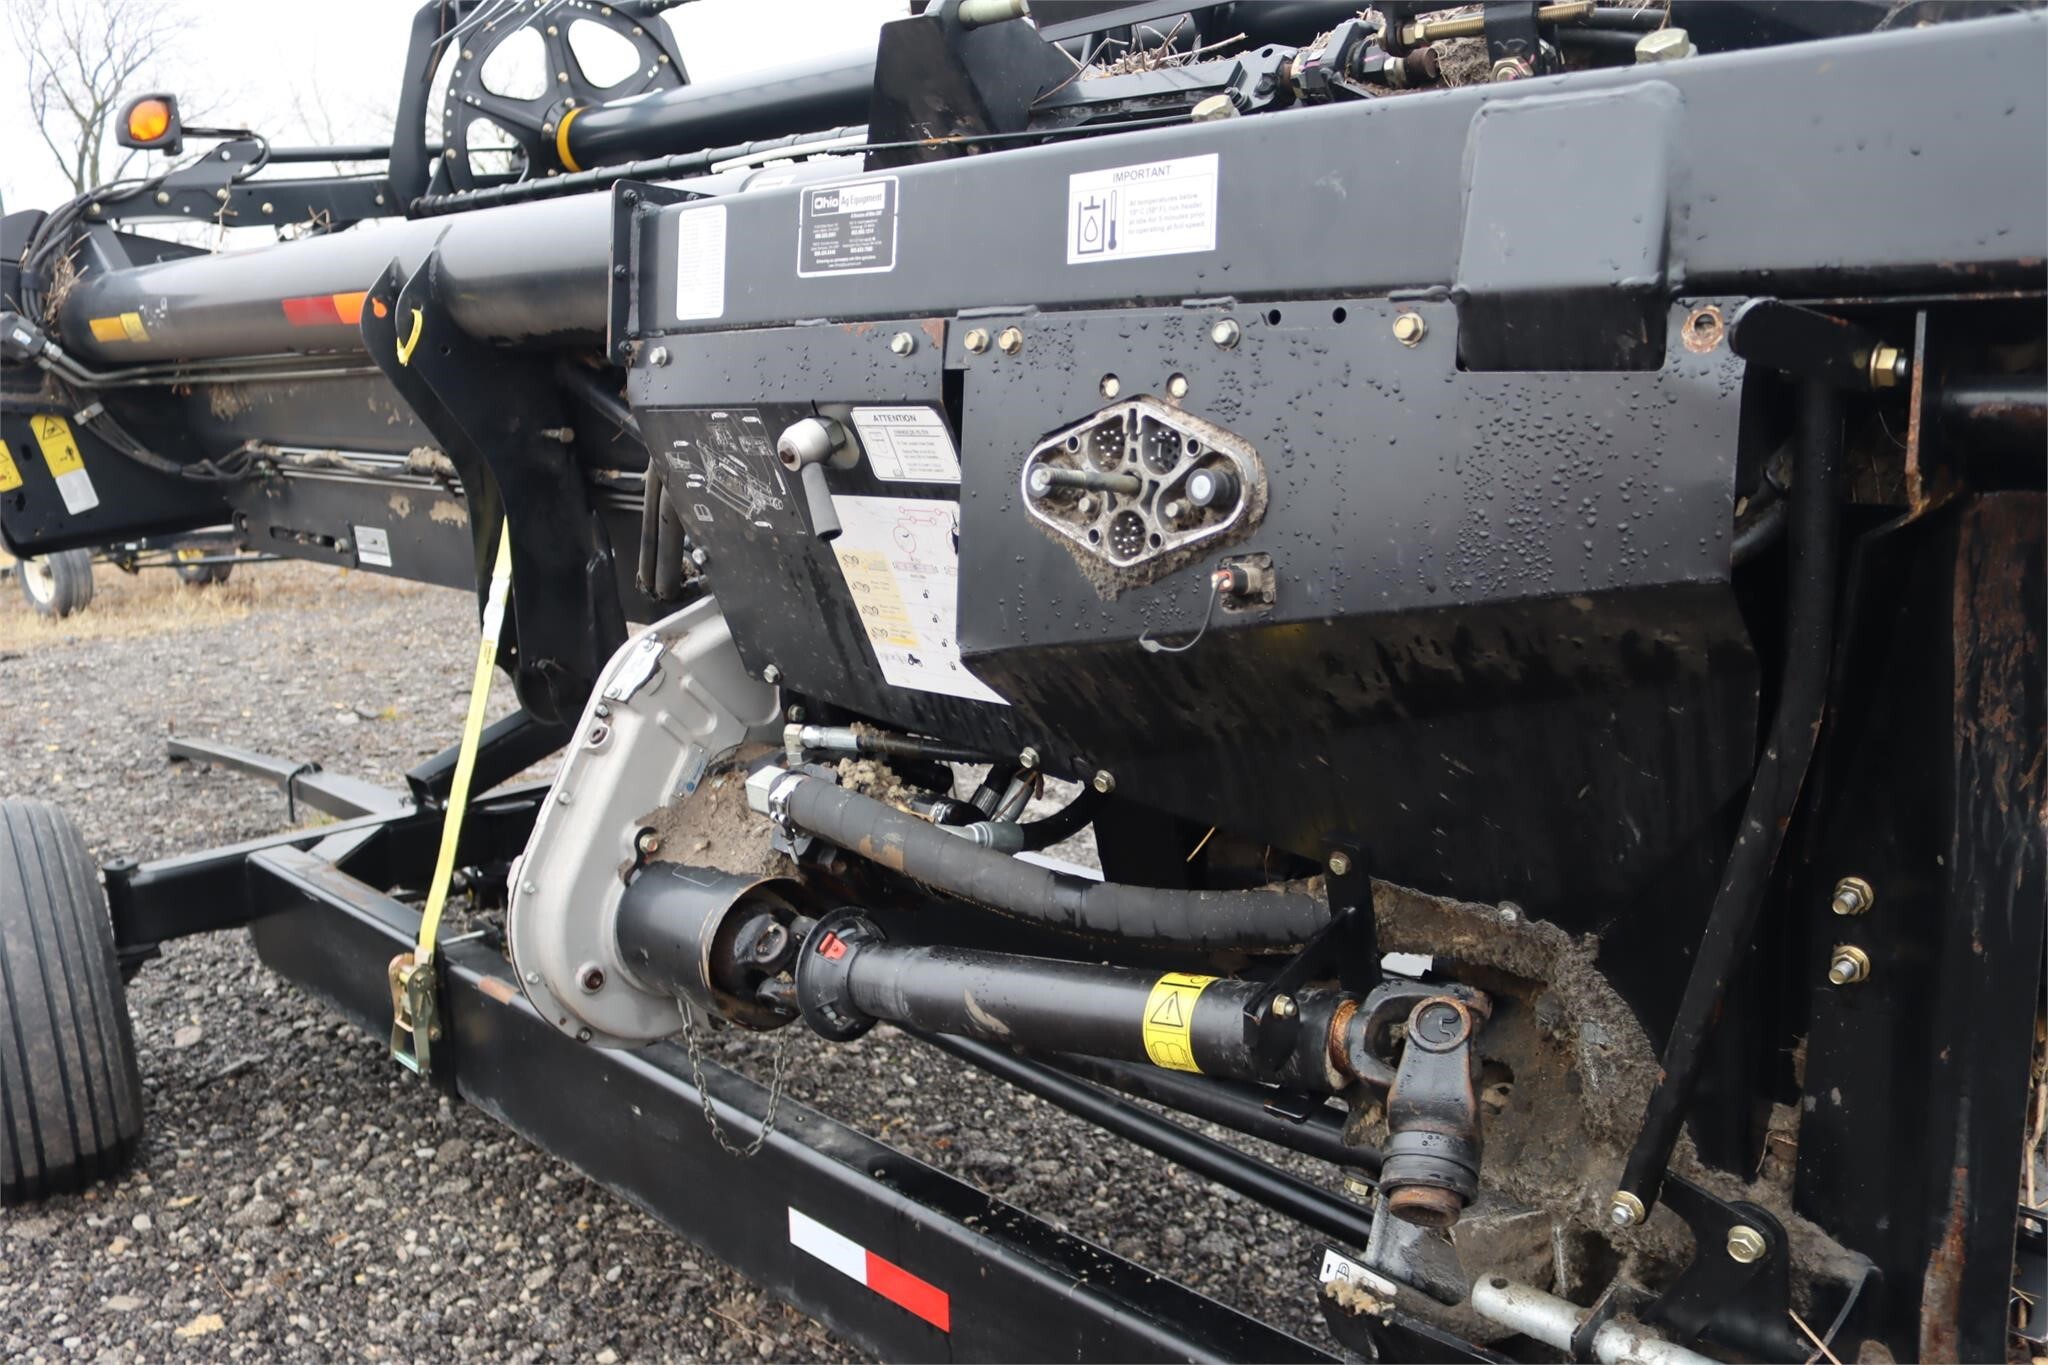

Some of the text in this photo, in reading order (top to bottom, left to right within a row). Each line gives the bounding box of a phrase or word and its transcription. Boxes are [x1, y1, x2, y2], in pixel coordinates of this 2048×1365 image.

[1113, 165, 1171, 183] IMPORTANT
[814, 193, 882, 209] Ohio Ag Equipment
[1137, 196, 1177, 206] temperatures
[1164, 213, 1188, 221] minutes
[1136, 225, 1165, 234] operating
[873, 413, 917, 423] ATTENTION
